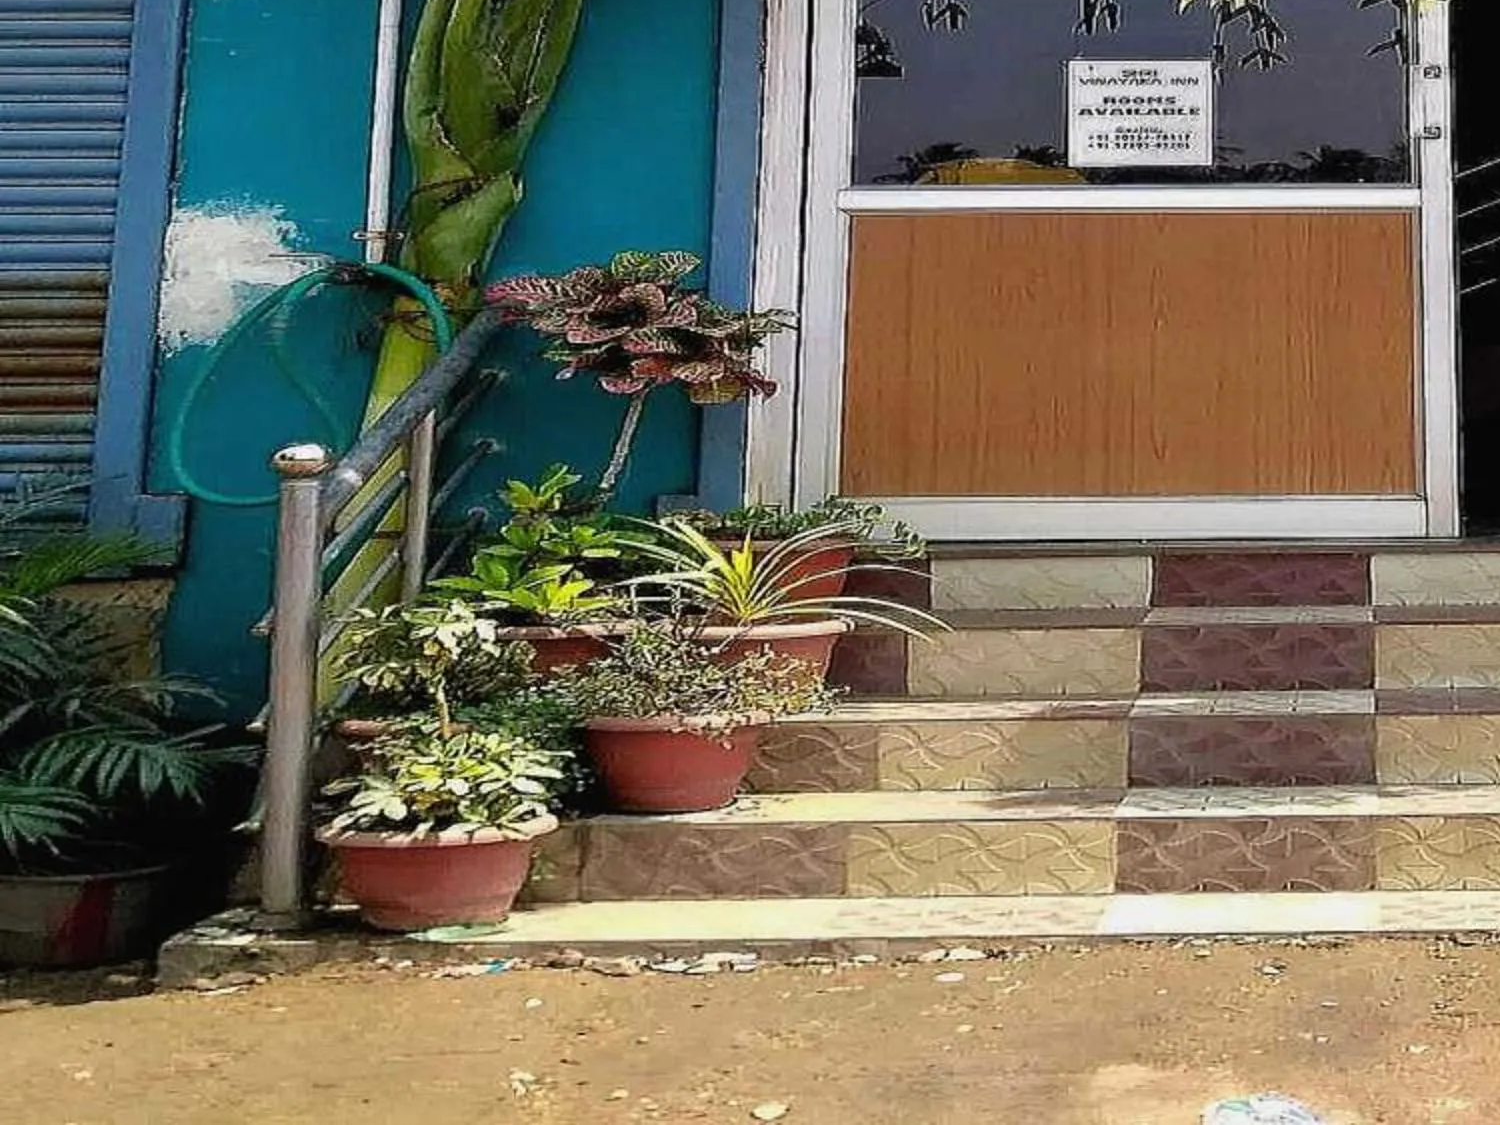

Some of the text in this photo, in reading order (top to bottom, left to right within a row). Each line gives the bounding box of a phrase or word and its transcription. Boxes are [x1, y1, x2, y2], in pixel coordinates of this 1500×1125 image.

[1170, 77, 1199, 86] INN
[1103, 96, 1177, 105] ROOMS
[1078, 108, 1201, 116] AVAILABLE
